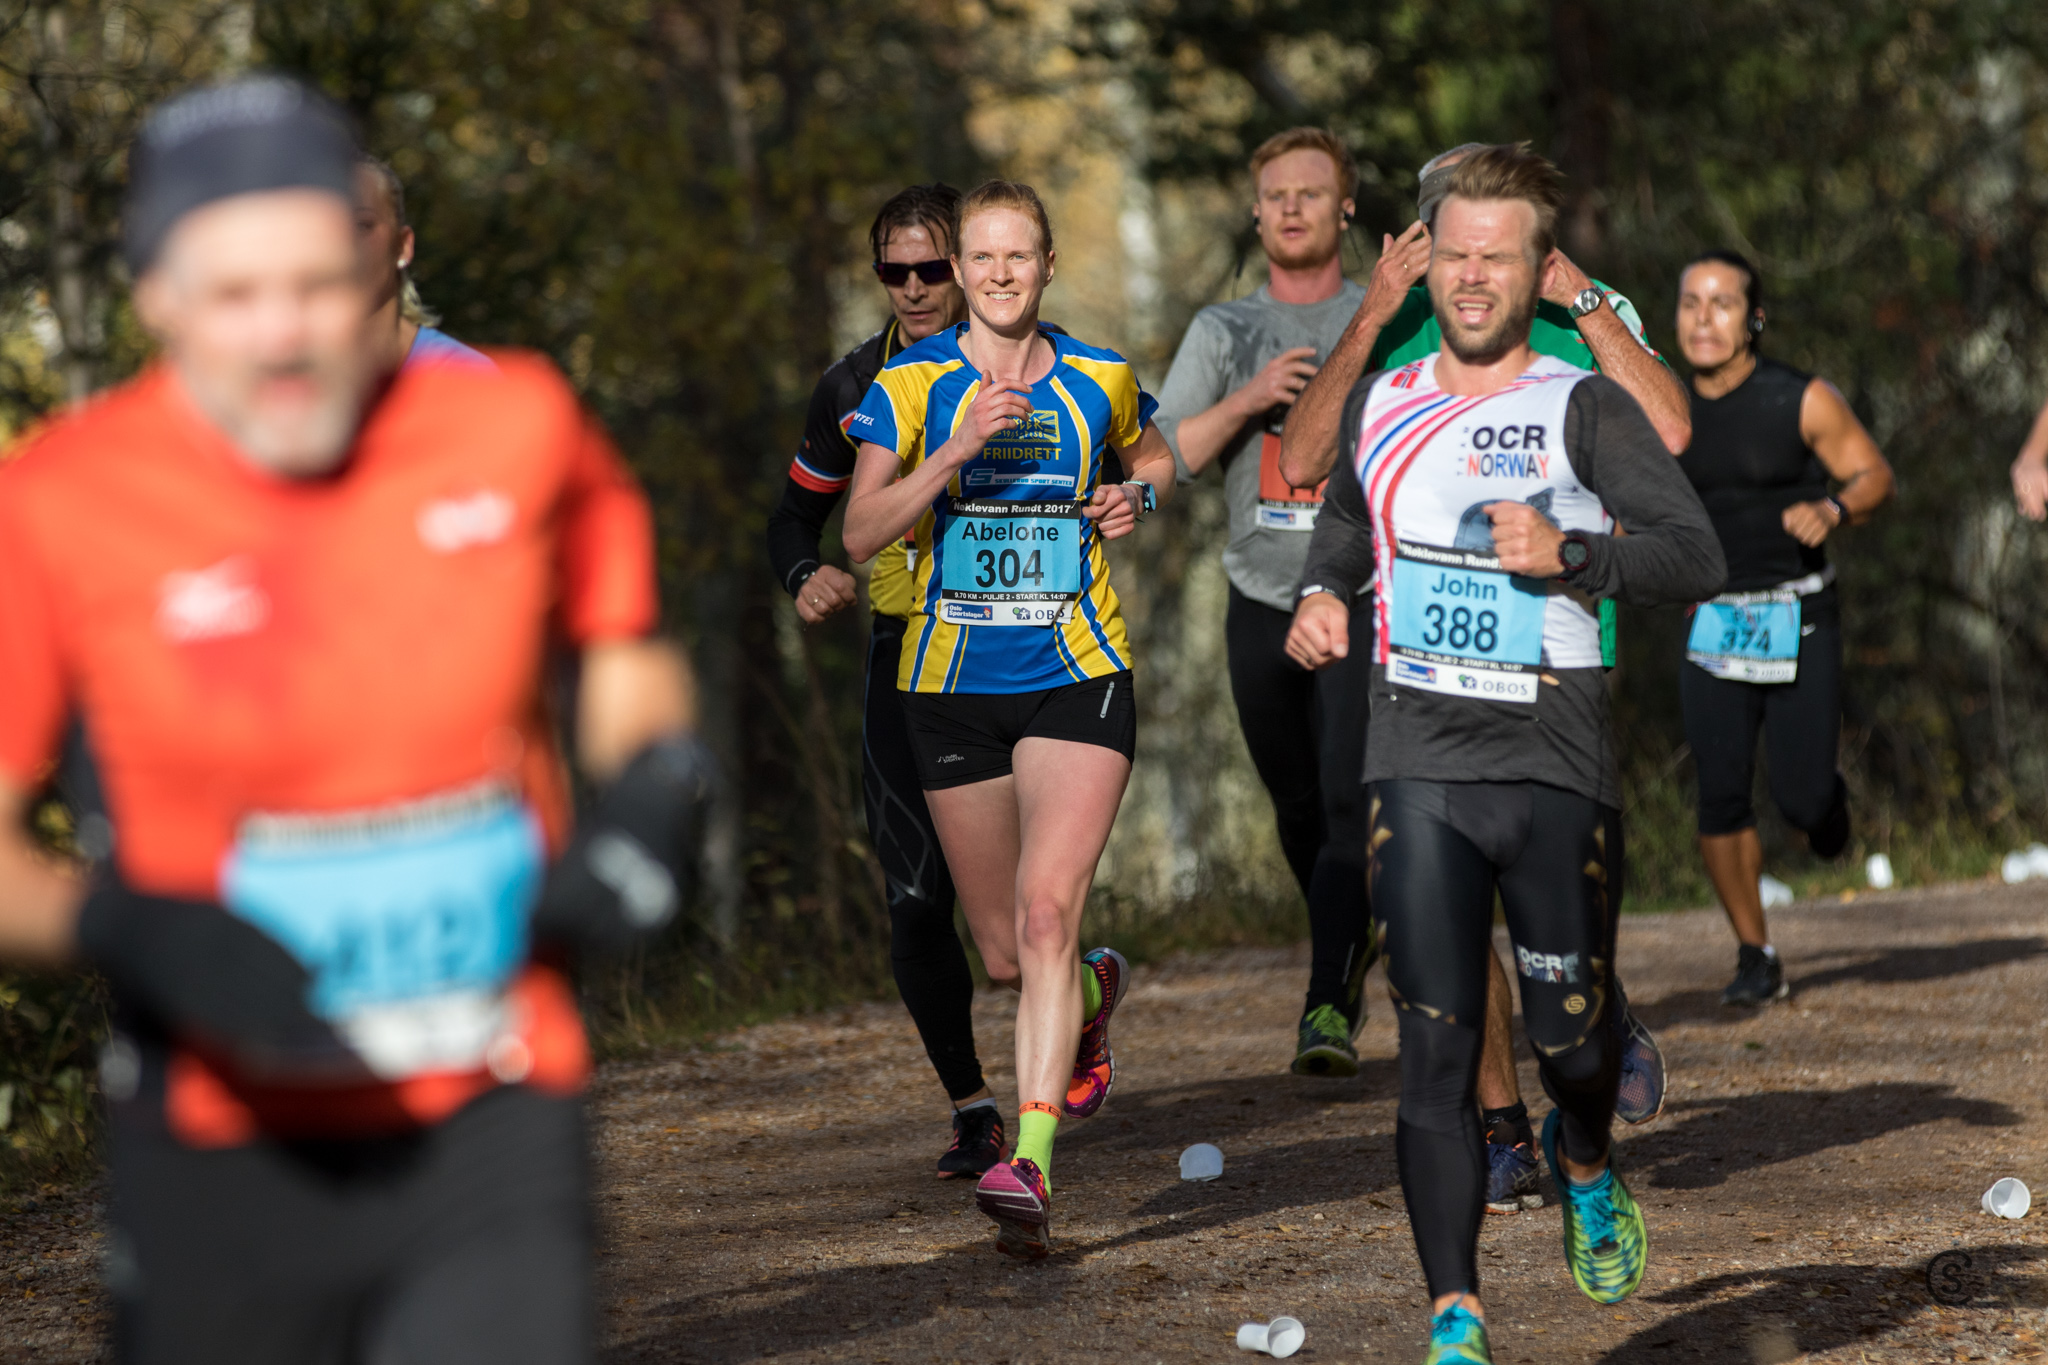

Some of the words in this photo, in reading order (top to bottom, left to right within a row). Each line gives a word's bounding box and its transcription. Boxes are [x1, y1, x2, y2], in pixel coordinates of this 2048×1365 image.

[1472, 424, 1547, 450] OCR
[983, 447, 1062, 461] FRIIDRETT
[1466, 452, 1550, 479] NORWAY
[1010, 504, 1042, 514] Rundt
[1044, 504, 1070, 514] 2017
[962, 521, 1059, 542] Abelone
[975, 548, 1044, 588] 304
[982, 593, 1005, 601] PULJE
[1432, 573, 1498, 601] John
[948, 610, 984, 619] Sportslager
[1422, 604, 1499, 654] 388
[1720, 627, 1771, 654] 374
[1463, 659, 1489, 669] START
[1482, 680, 1528, 696] OBOS
[1518, 945, 1563, 970] OCR
